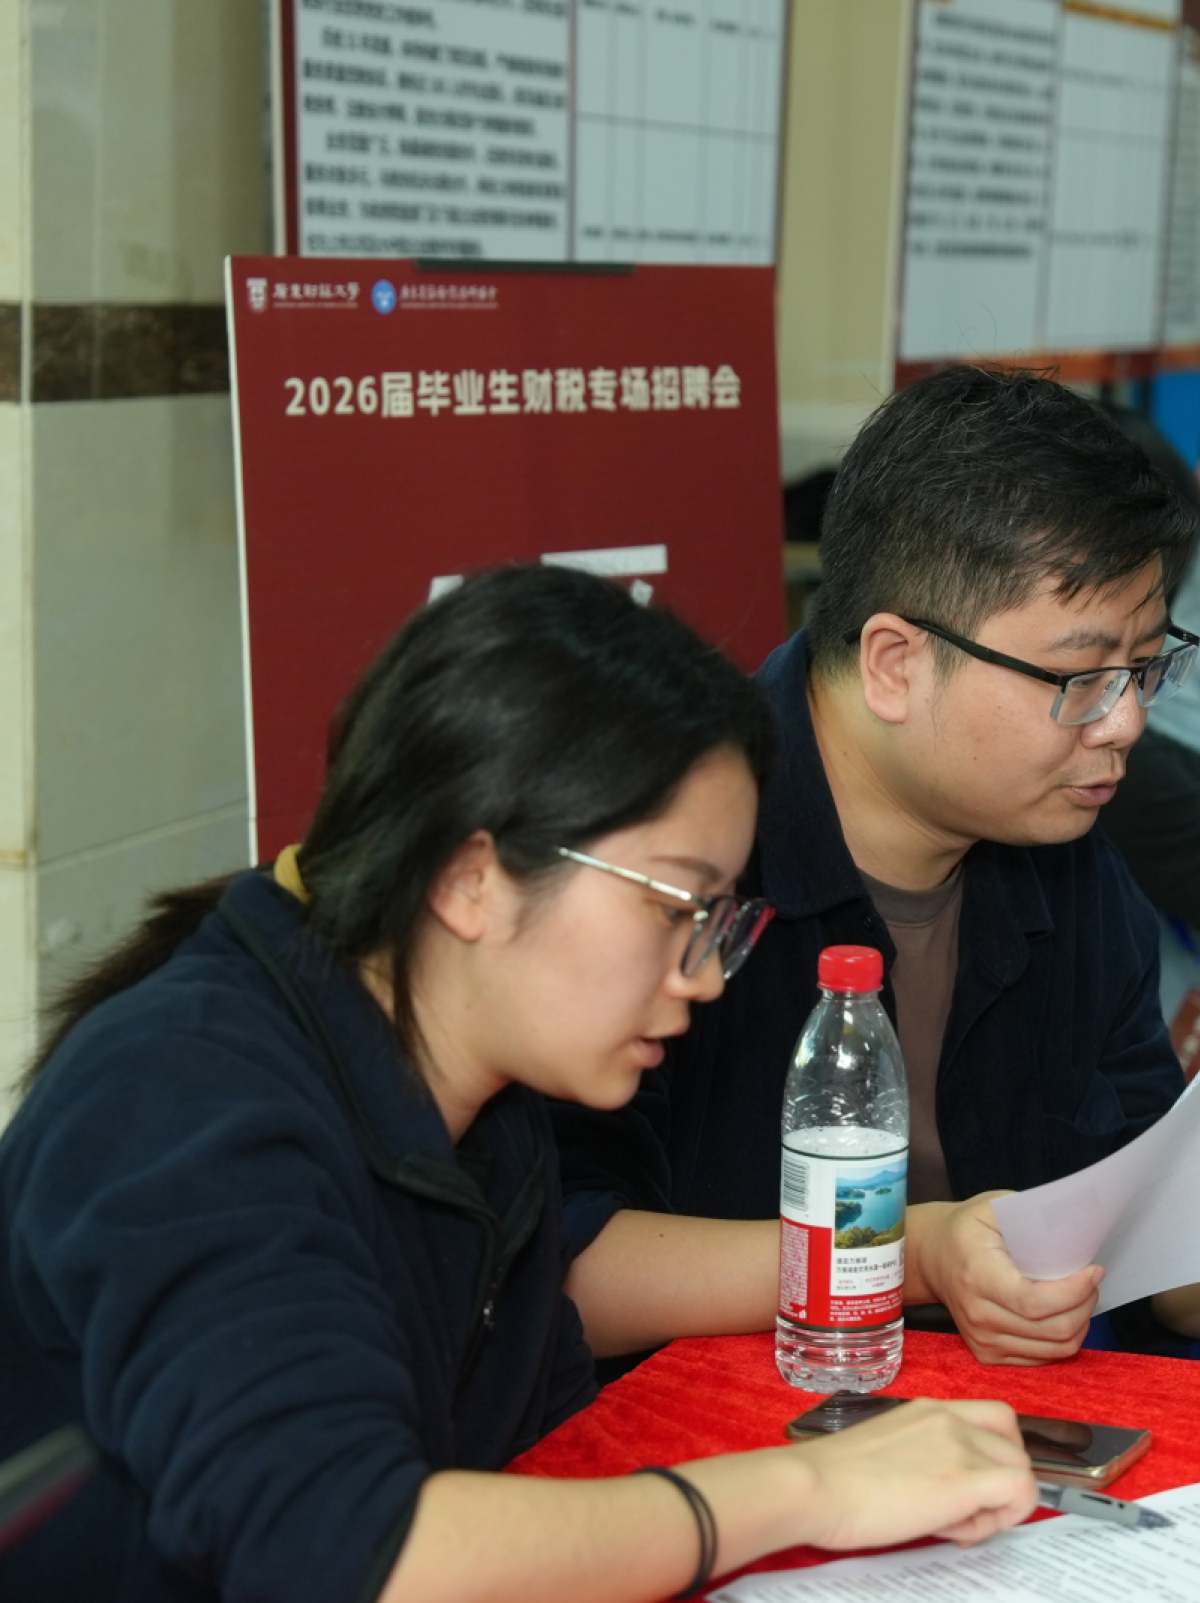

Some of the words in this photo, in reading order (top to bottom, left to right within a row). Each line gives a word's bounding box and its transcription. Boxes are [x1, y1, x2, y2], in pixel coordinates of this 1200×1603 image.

[284, 365, 741, 418] 2026届毕业生财税专场招聘会
